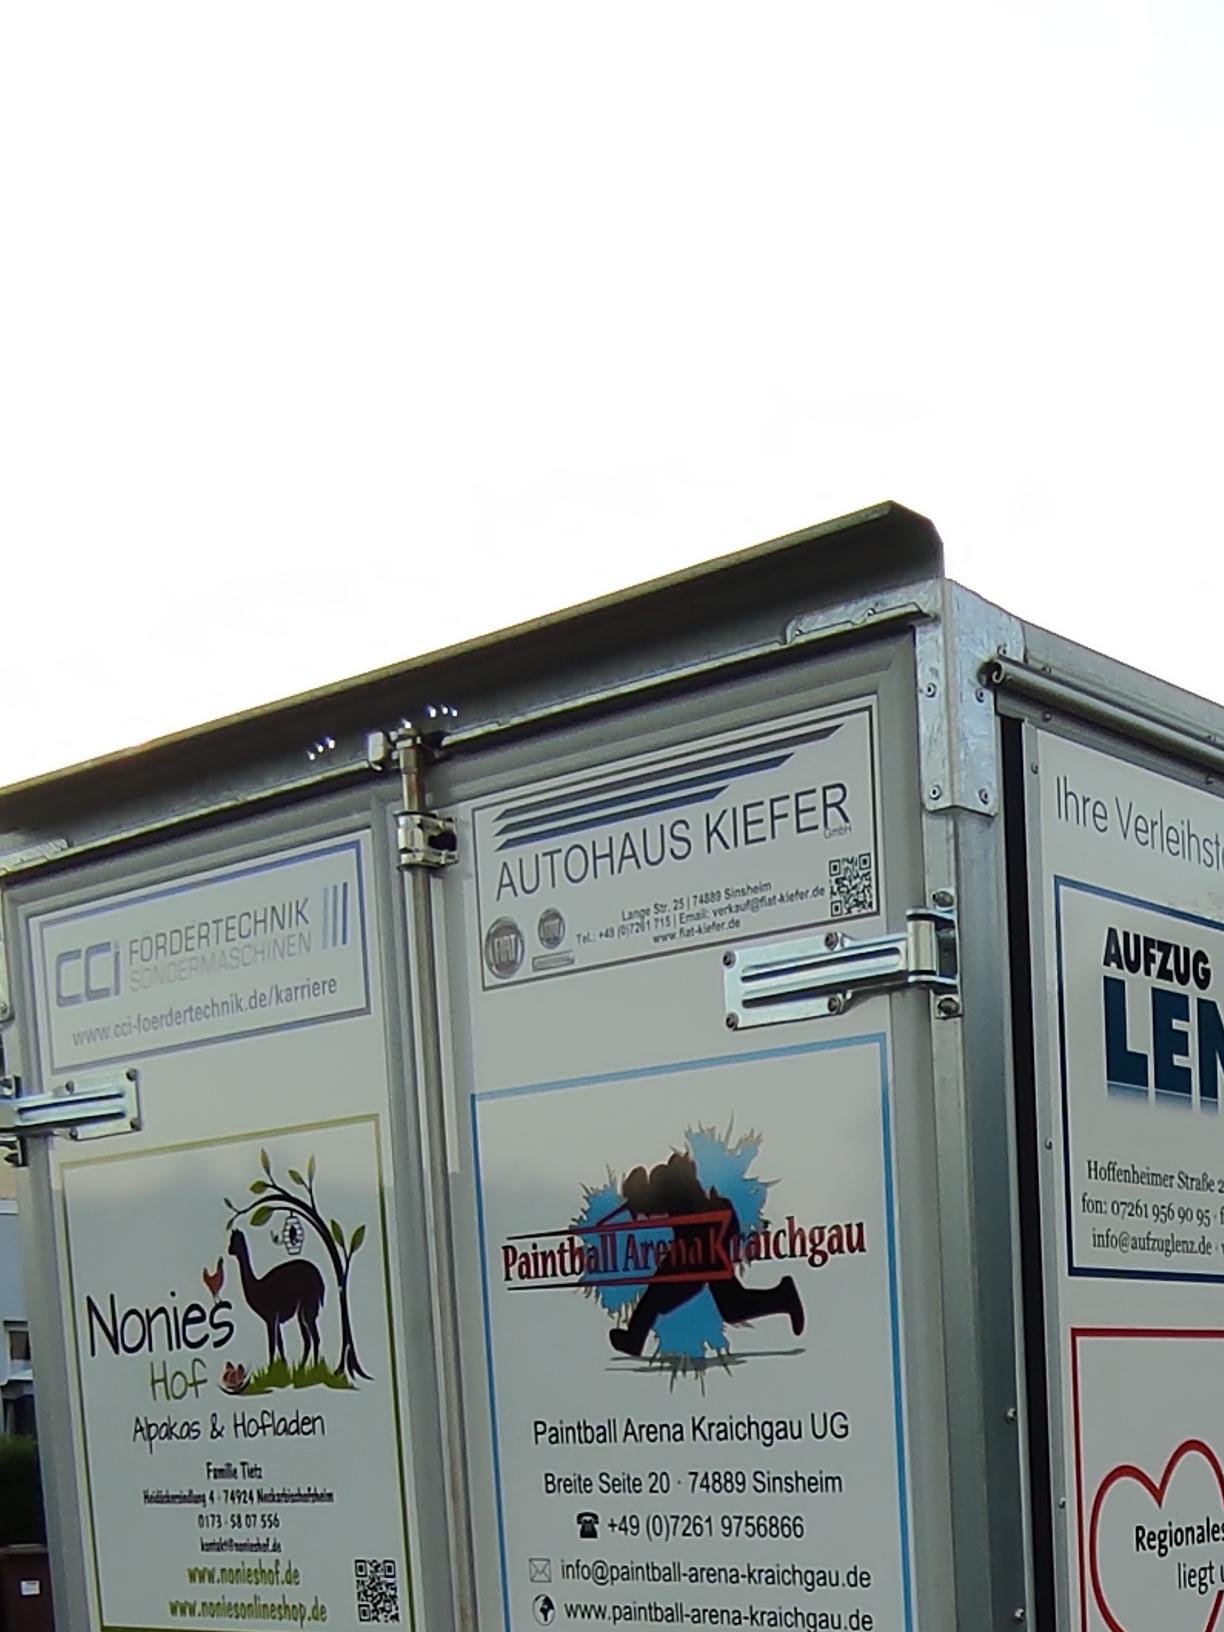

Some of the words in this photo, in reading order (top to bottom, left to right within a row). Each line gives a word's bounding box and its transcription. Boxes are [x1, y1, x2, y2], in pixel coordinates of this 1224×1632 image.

[1056, 776, 1109, 834] Ihre
[496, 819, 692, 901] AUTOHAUS
[705, 782, 850, 854] KIEFER
[824, 825, 852, 839] GmbH
[621, 904, 651, 922] Lange
[653, 901, 671, 918] Str.
[672, 898, 685, 911] 25
[725, 880, 772, 900] Sinsheim
[680, 908, 709, 926] Email:
[653, 917, 741, 944] www.fiat-kiefer.de
[130, 931, 312, 993] SONDERMASCHINEN
[1103, 926, 1211, 991] AUFZUG
[72, 976, 338, 1048] www.cci-foerdertechnik.de/karriere
[1087, 1160, 1175, 1190] Hoffenheimer
[1177, 1169, 1215, 1194] Straße
[1217, 1179, 1224, 1194] 2
[1081, 1193, 1108, 1216] fon:
[1111, 1201, 1150, 1223] 07261
[1152, 1203, 1175, 1221] 956
[1177, 1206, 1194, 1224] 90
[1197, 1208, 1211, 1227] 95
[502, 1230, 618, 1282] Paintball
[623, 1230, 700, 1274] Arena
[706, 1214, 868, 1269] Kraichgau
[1092, 1227, 1212, 1257] info@aufzuglenz.de
[86, 1291, 234, 1357] Nonies
[150, 1358, 208, 1401] Hof
[132, 1416, 200, 1454] Alpakas
[210, 1413, 225, 1439] &
[233, 1410, 326, 1438] Hofladen
[533, 1417, 618, 1445] Paintball
[623, 1417, 684, 1444] Arena
[691, 1413, 803, 1448] Kraichgau
[810, 1411, 850, 1440] UG
[222, 1490, 255, 1504] 74924
[544, 1472, 593, 1495] Breite
[599, 1472, 642, 1495] Seite
[647, 1472, 671, 1494] 20
[688, 1470, 747, 1494] 74889
[752, 1469, 843, 1494] Sinsheim
[198, 1514, 222, 1529] 0173
[607, 1515, 640, 1537] +49
[645, 1513, 714, 1542] (0)7261
[721, 1515, 805, 1539] 9756866
[187, 1559, 300, 1586] www.nonieshof.de
[560, 1559, 872, 1593] info@paintball-arena-kraichgau.de
[1177, 1559, 1216, 1595] liegt
[169, 1595, 327, 1628] www.noniesonlineshop.de
